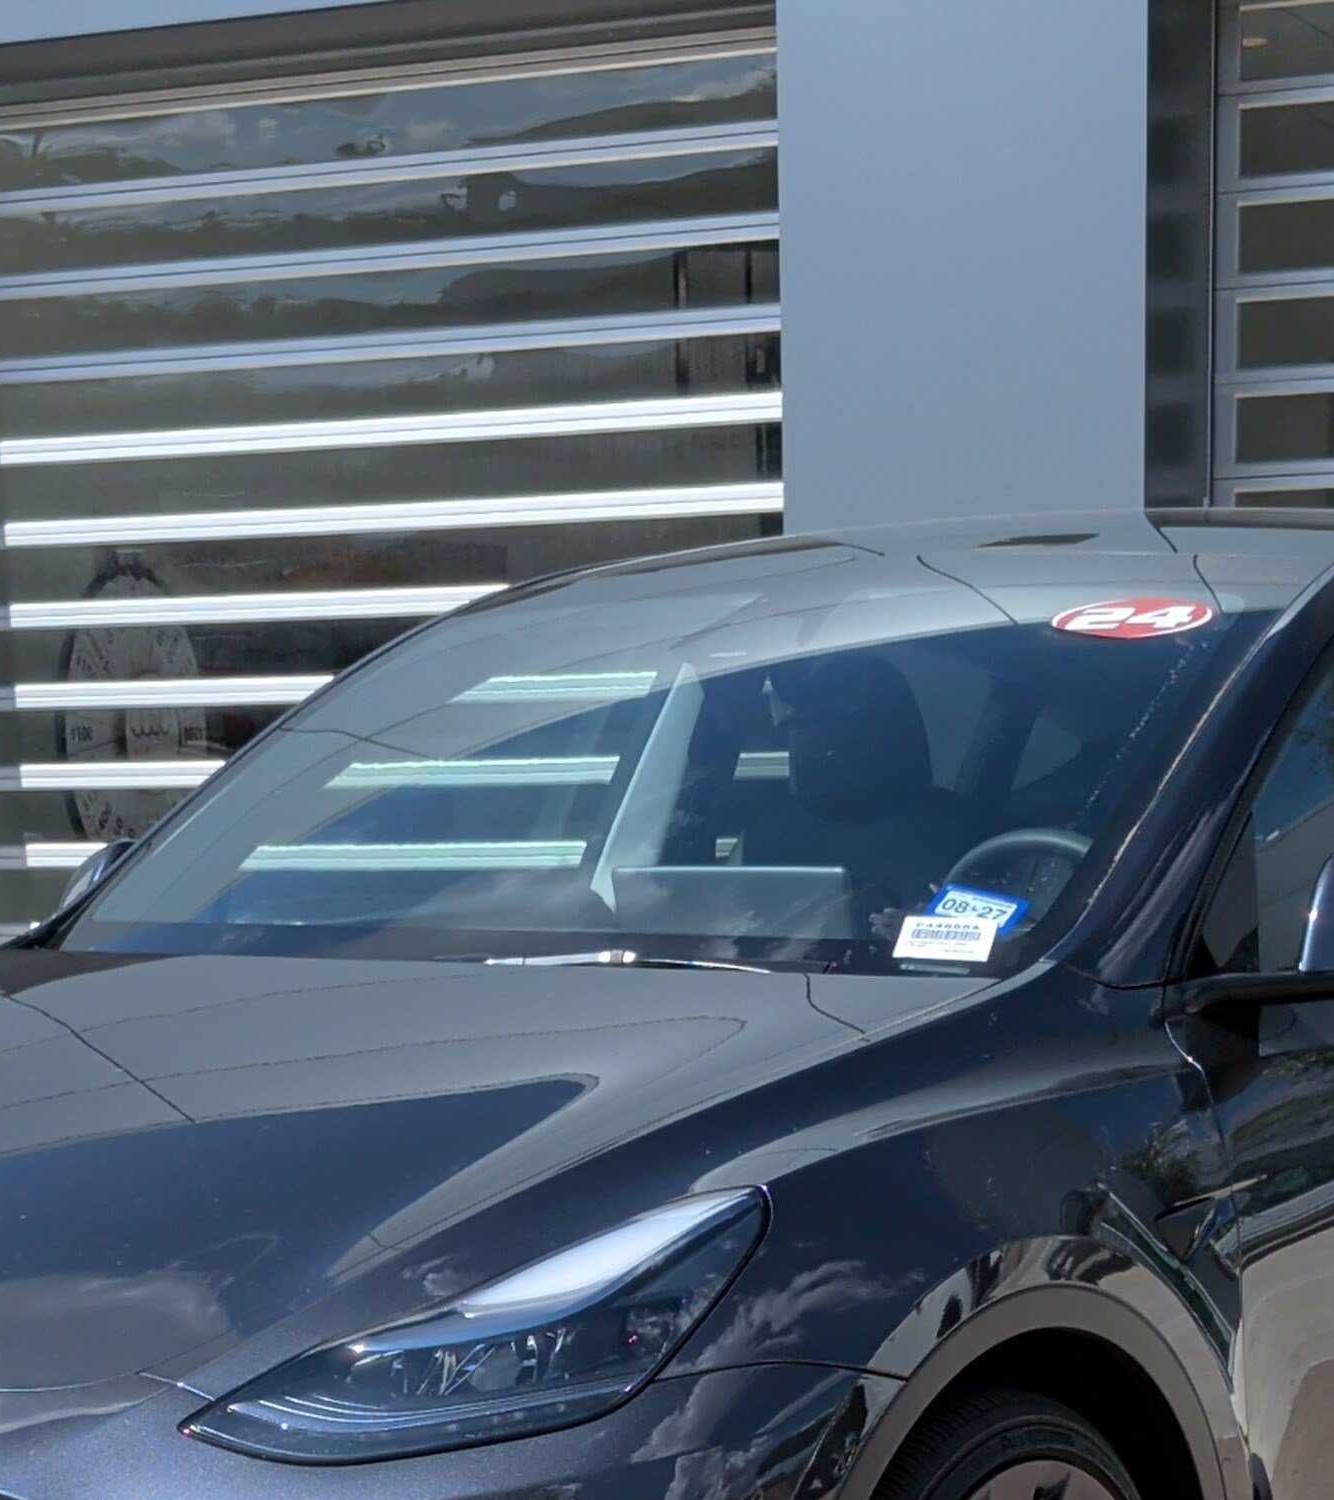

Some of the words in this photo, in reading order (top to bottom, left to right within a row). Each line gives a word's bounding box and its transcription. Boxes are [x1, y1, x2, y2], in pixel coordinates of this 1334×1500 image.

[1064, 605, 1197, 630] 24
[942, 898, 969, 914] 08
[976, 905, 1008, 920] 27
